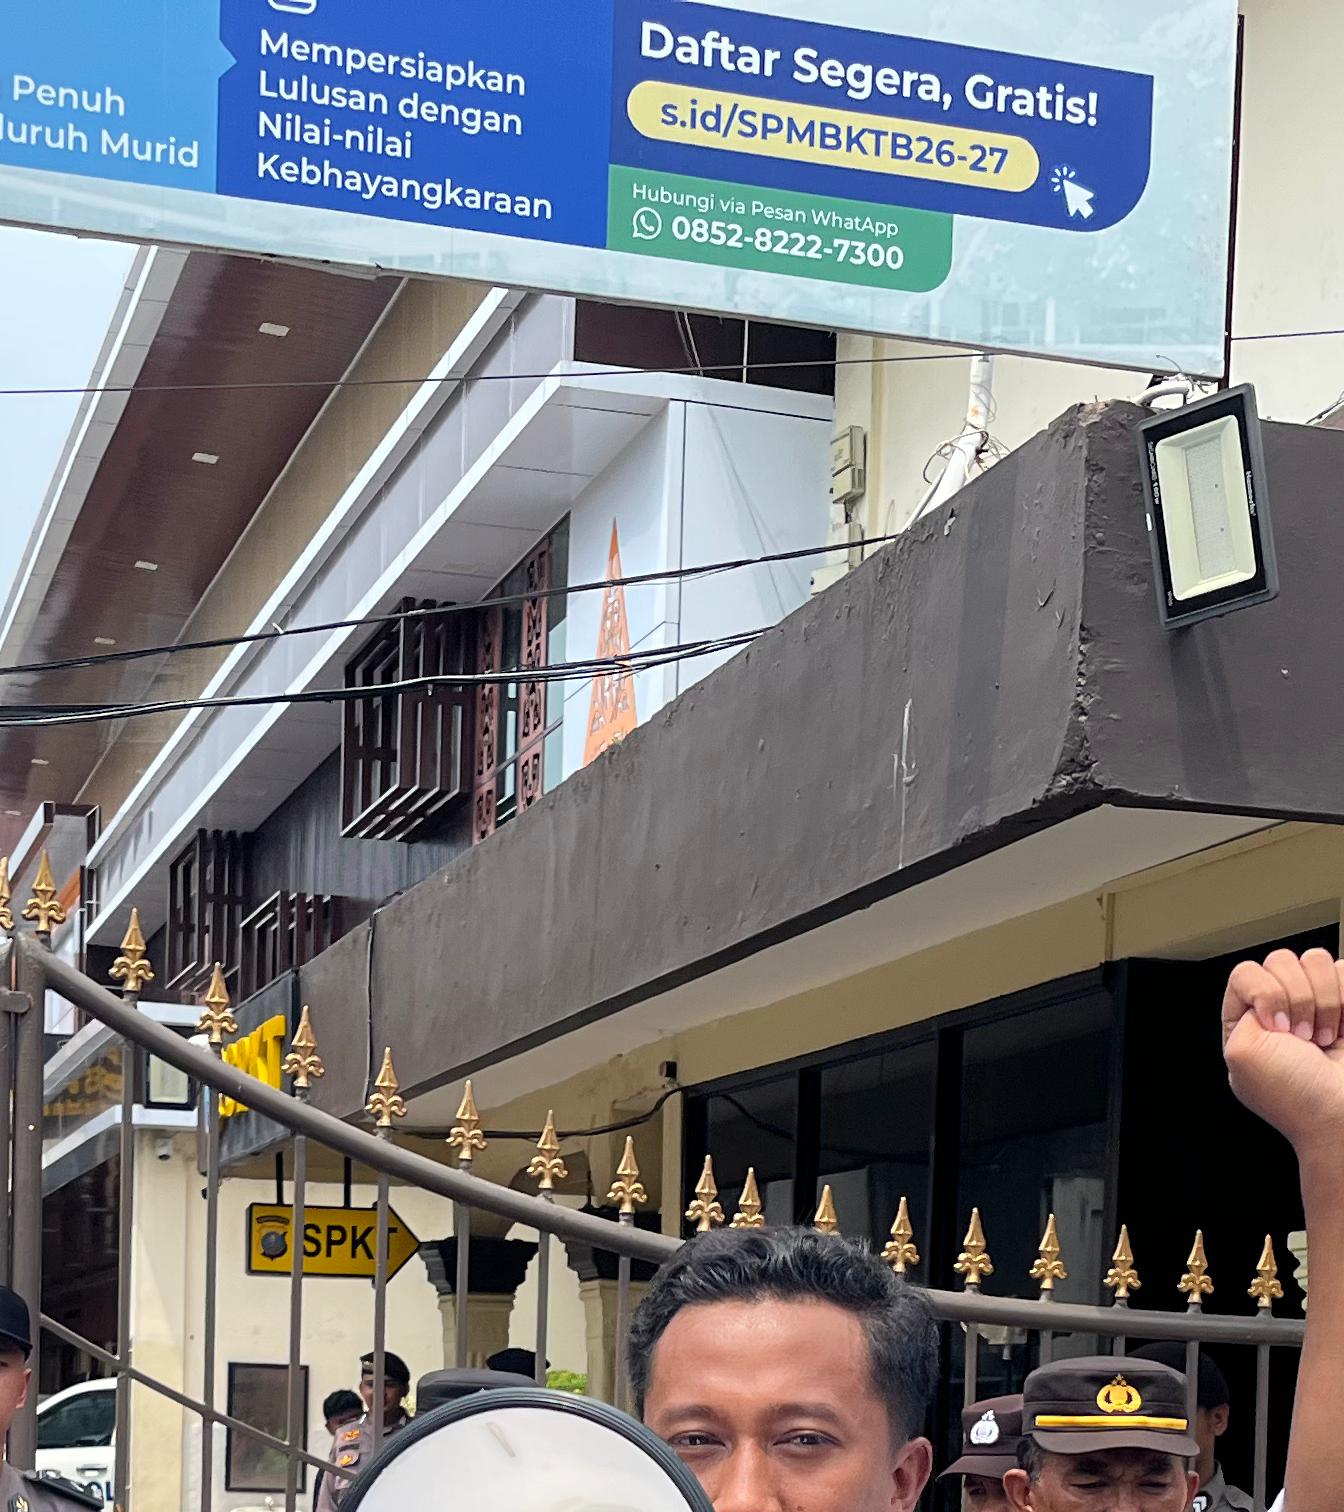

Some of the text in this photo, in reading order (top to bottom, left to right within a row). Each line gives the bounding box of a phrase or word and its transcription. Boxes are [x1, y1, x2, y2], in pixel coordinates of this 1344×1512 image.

[260, 29, 526, 96] Mempersiapkan
[640, 21, 1098, 126] Daftar Segera, Gratis!
[13, 74, 125, 116] Penuh
[259, 70, 523, 135] Lulusan dengan
[101, 128, 199, 168] Murid
[258, 111, 413, 159] Nilai-nilai
[660, 99, 1009, 176] s.id/SPMBKTB26-27
[257, 152, 552, 220] Kebhayangkaraan
[632, 183, 899, 238] Hubungi via Pesan WhatApp
[671, 216, 905, 270] 0852-8222-7300
[303, 1223, 400, 1260] SPKT
